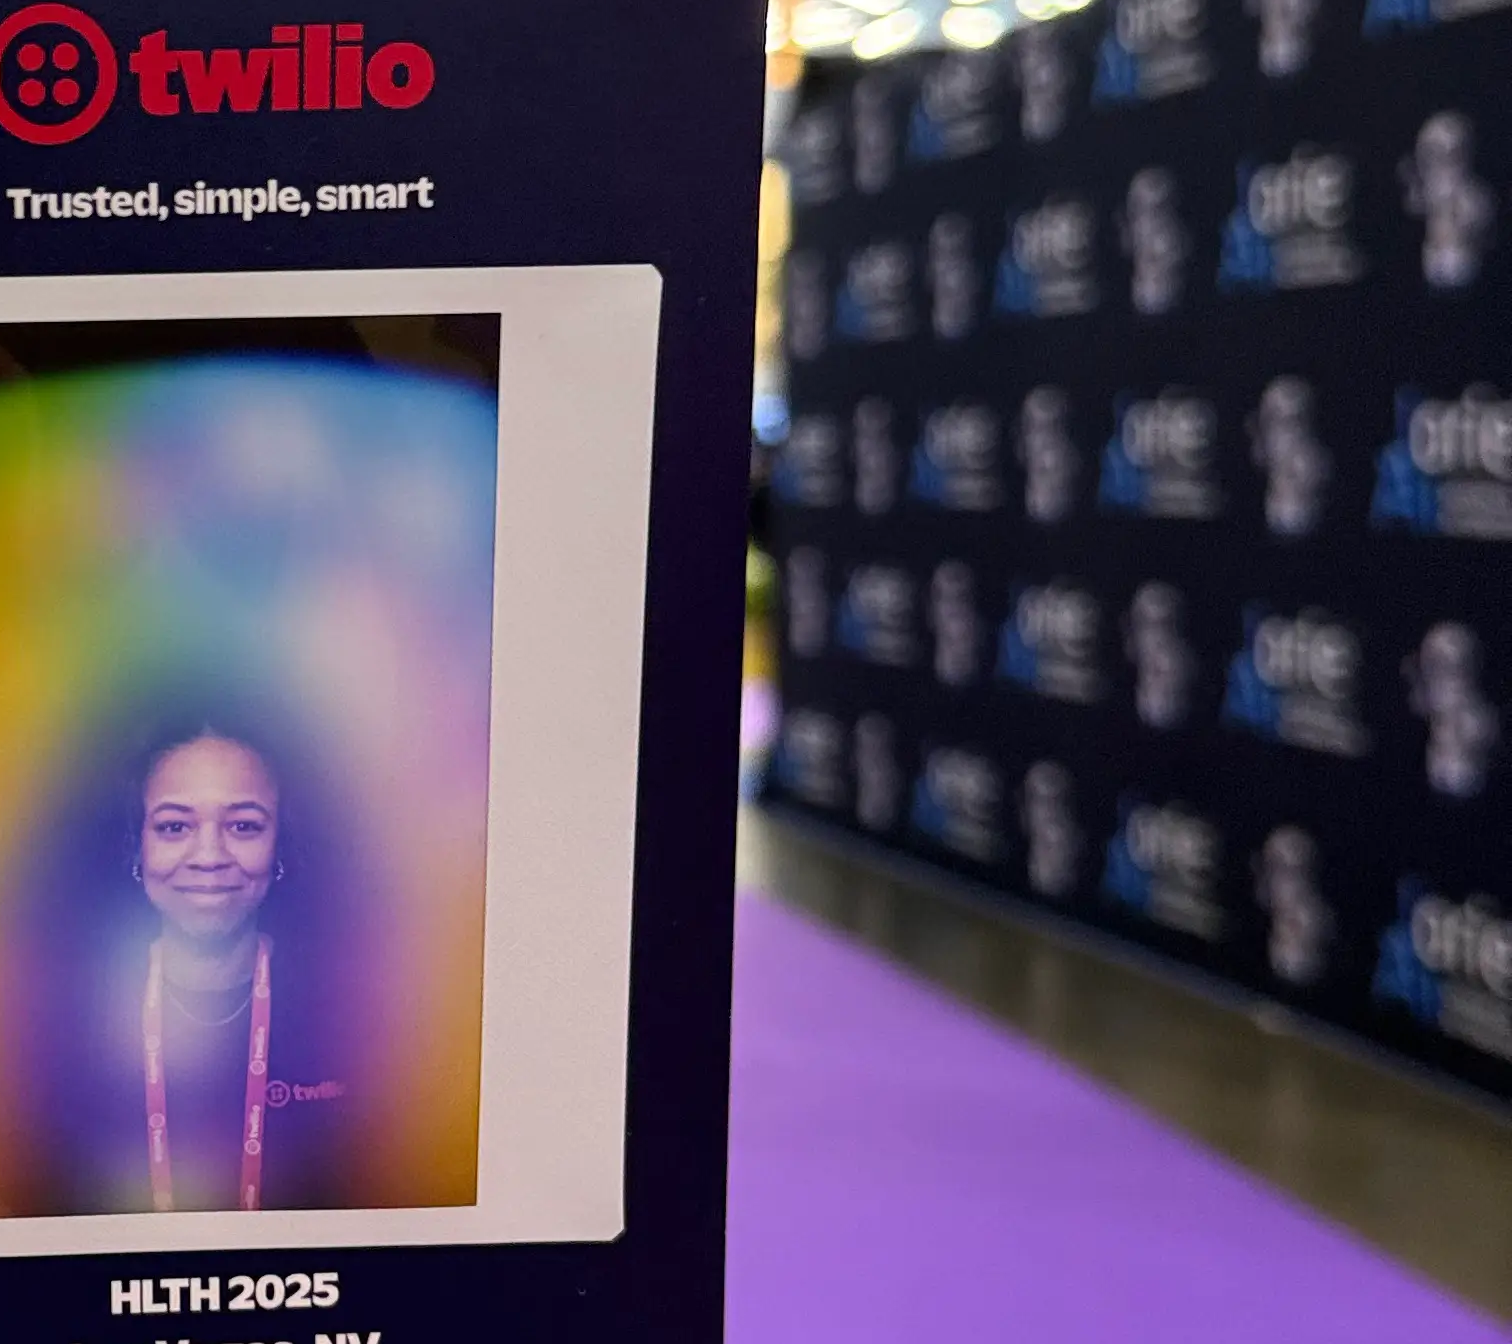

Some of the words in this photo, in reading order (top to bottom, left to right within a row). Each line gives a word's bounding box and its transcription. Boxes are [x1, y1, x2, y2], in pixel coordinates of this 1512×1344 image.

[129, 23, 436, 116] twilio
[6, 182, 169, 221] Trusted,
[174, 179, 311, 221] simple,
[316, 176, 434, 212] smart
[110, 1276, 221, 1315] HLTH
[227, 1271, 341, 1311] 2025
